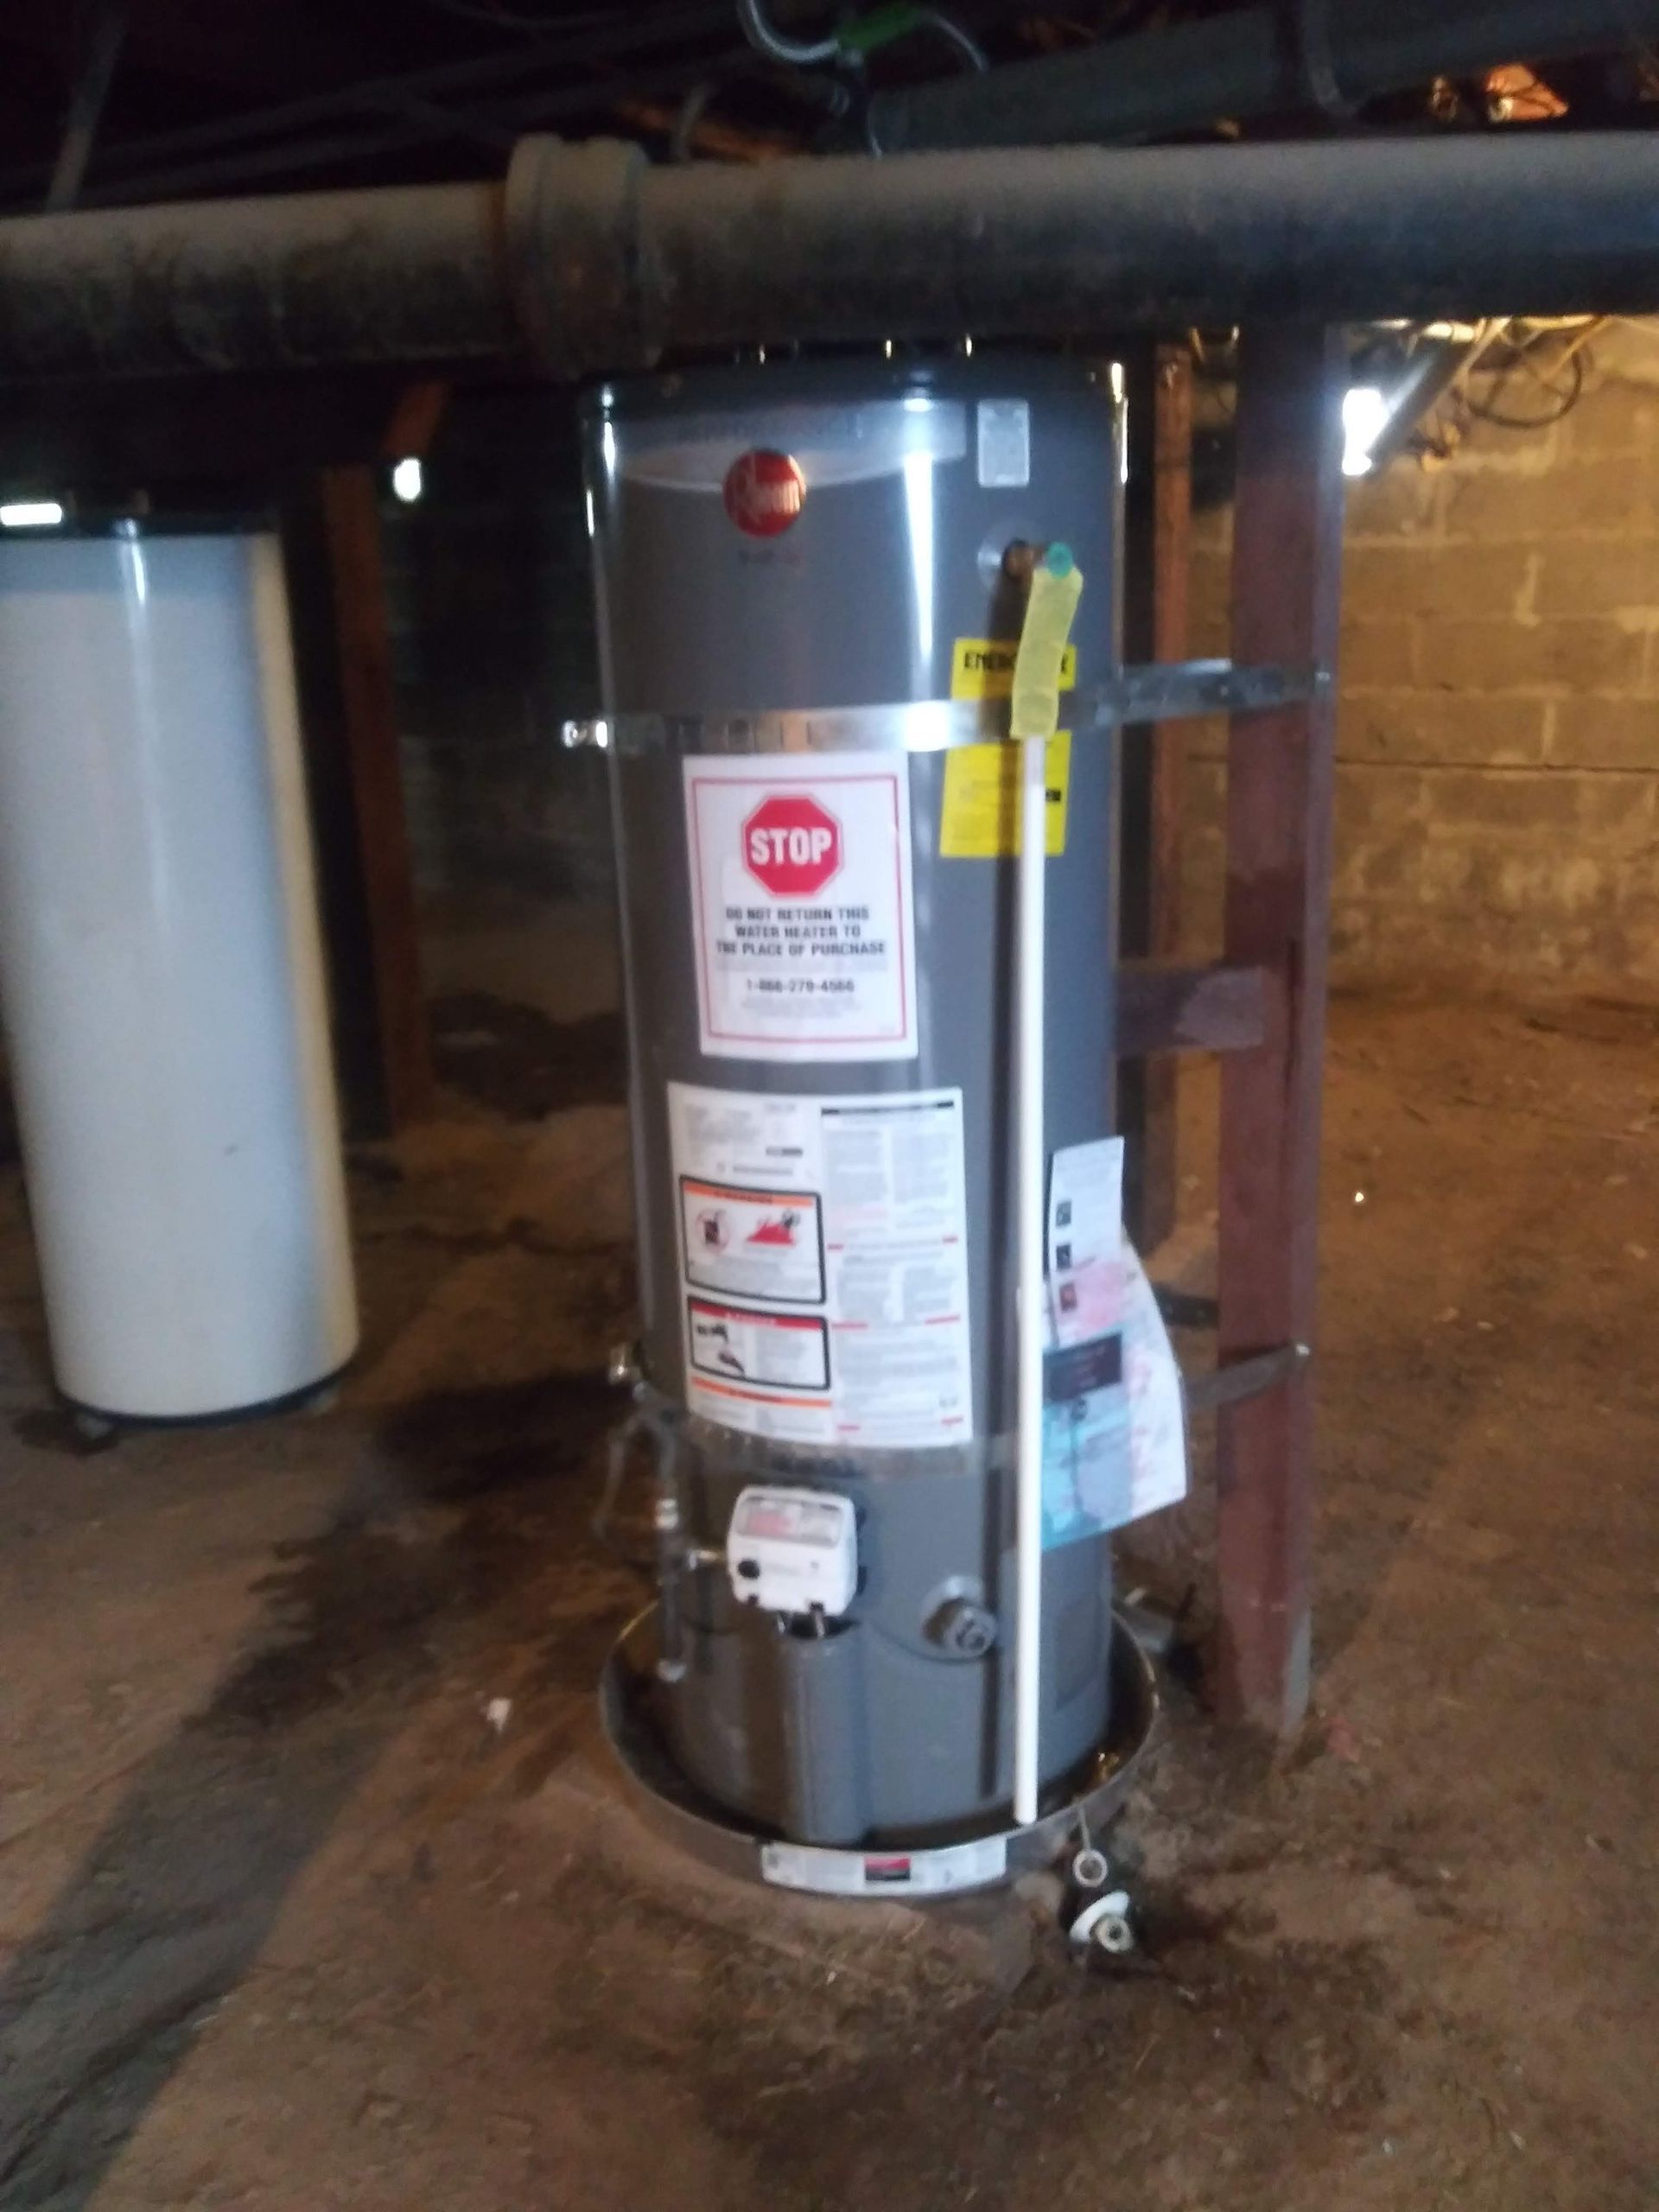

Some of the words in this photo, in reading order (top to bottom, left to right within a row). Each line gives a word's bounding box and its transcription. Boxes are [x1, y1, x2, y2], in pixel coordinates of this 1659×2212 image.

[750, 826, 832, 866] STOP
[725, 907, 743, 920] DO
[747, 906, 772, 920] NOT
[778, 907, 833, 921] RETURN
[839, 906, 870, 920] THIS
[735, 925, 779, 938] WATER
[784, 925, 838, 938] HEATER
[844, 924, 861, 938] TO
[716, 940, 737, 955] THE
[741, 942, 783, 956] PLACE
[788, 943, 804, 957] OF
[810, 941, 887, 957] PURCHASE
